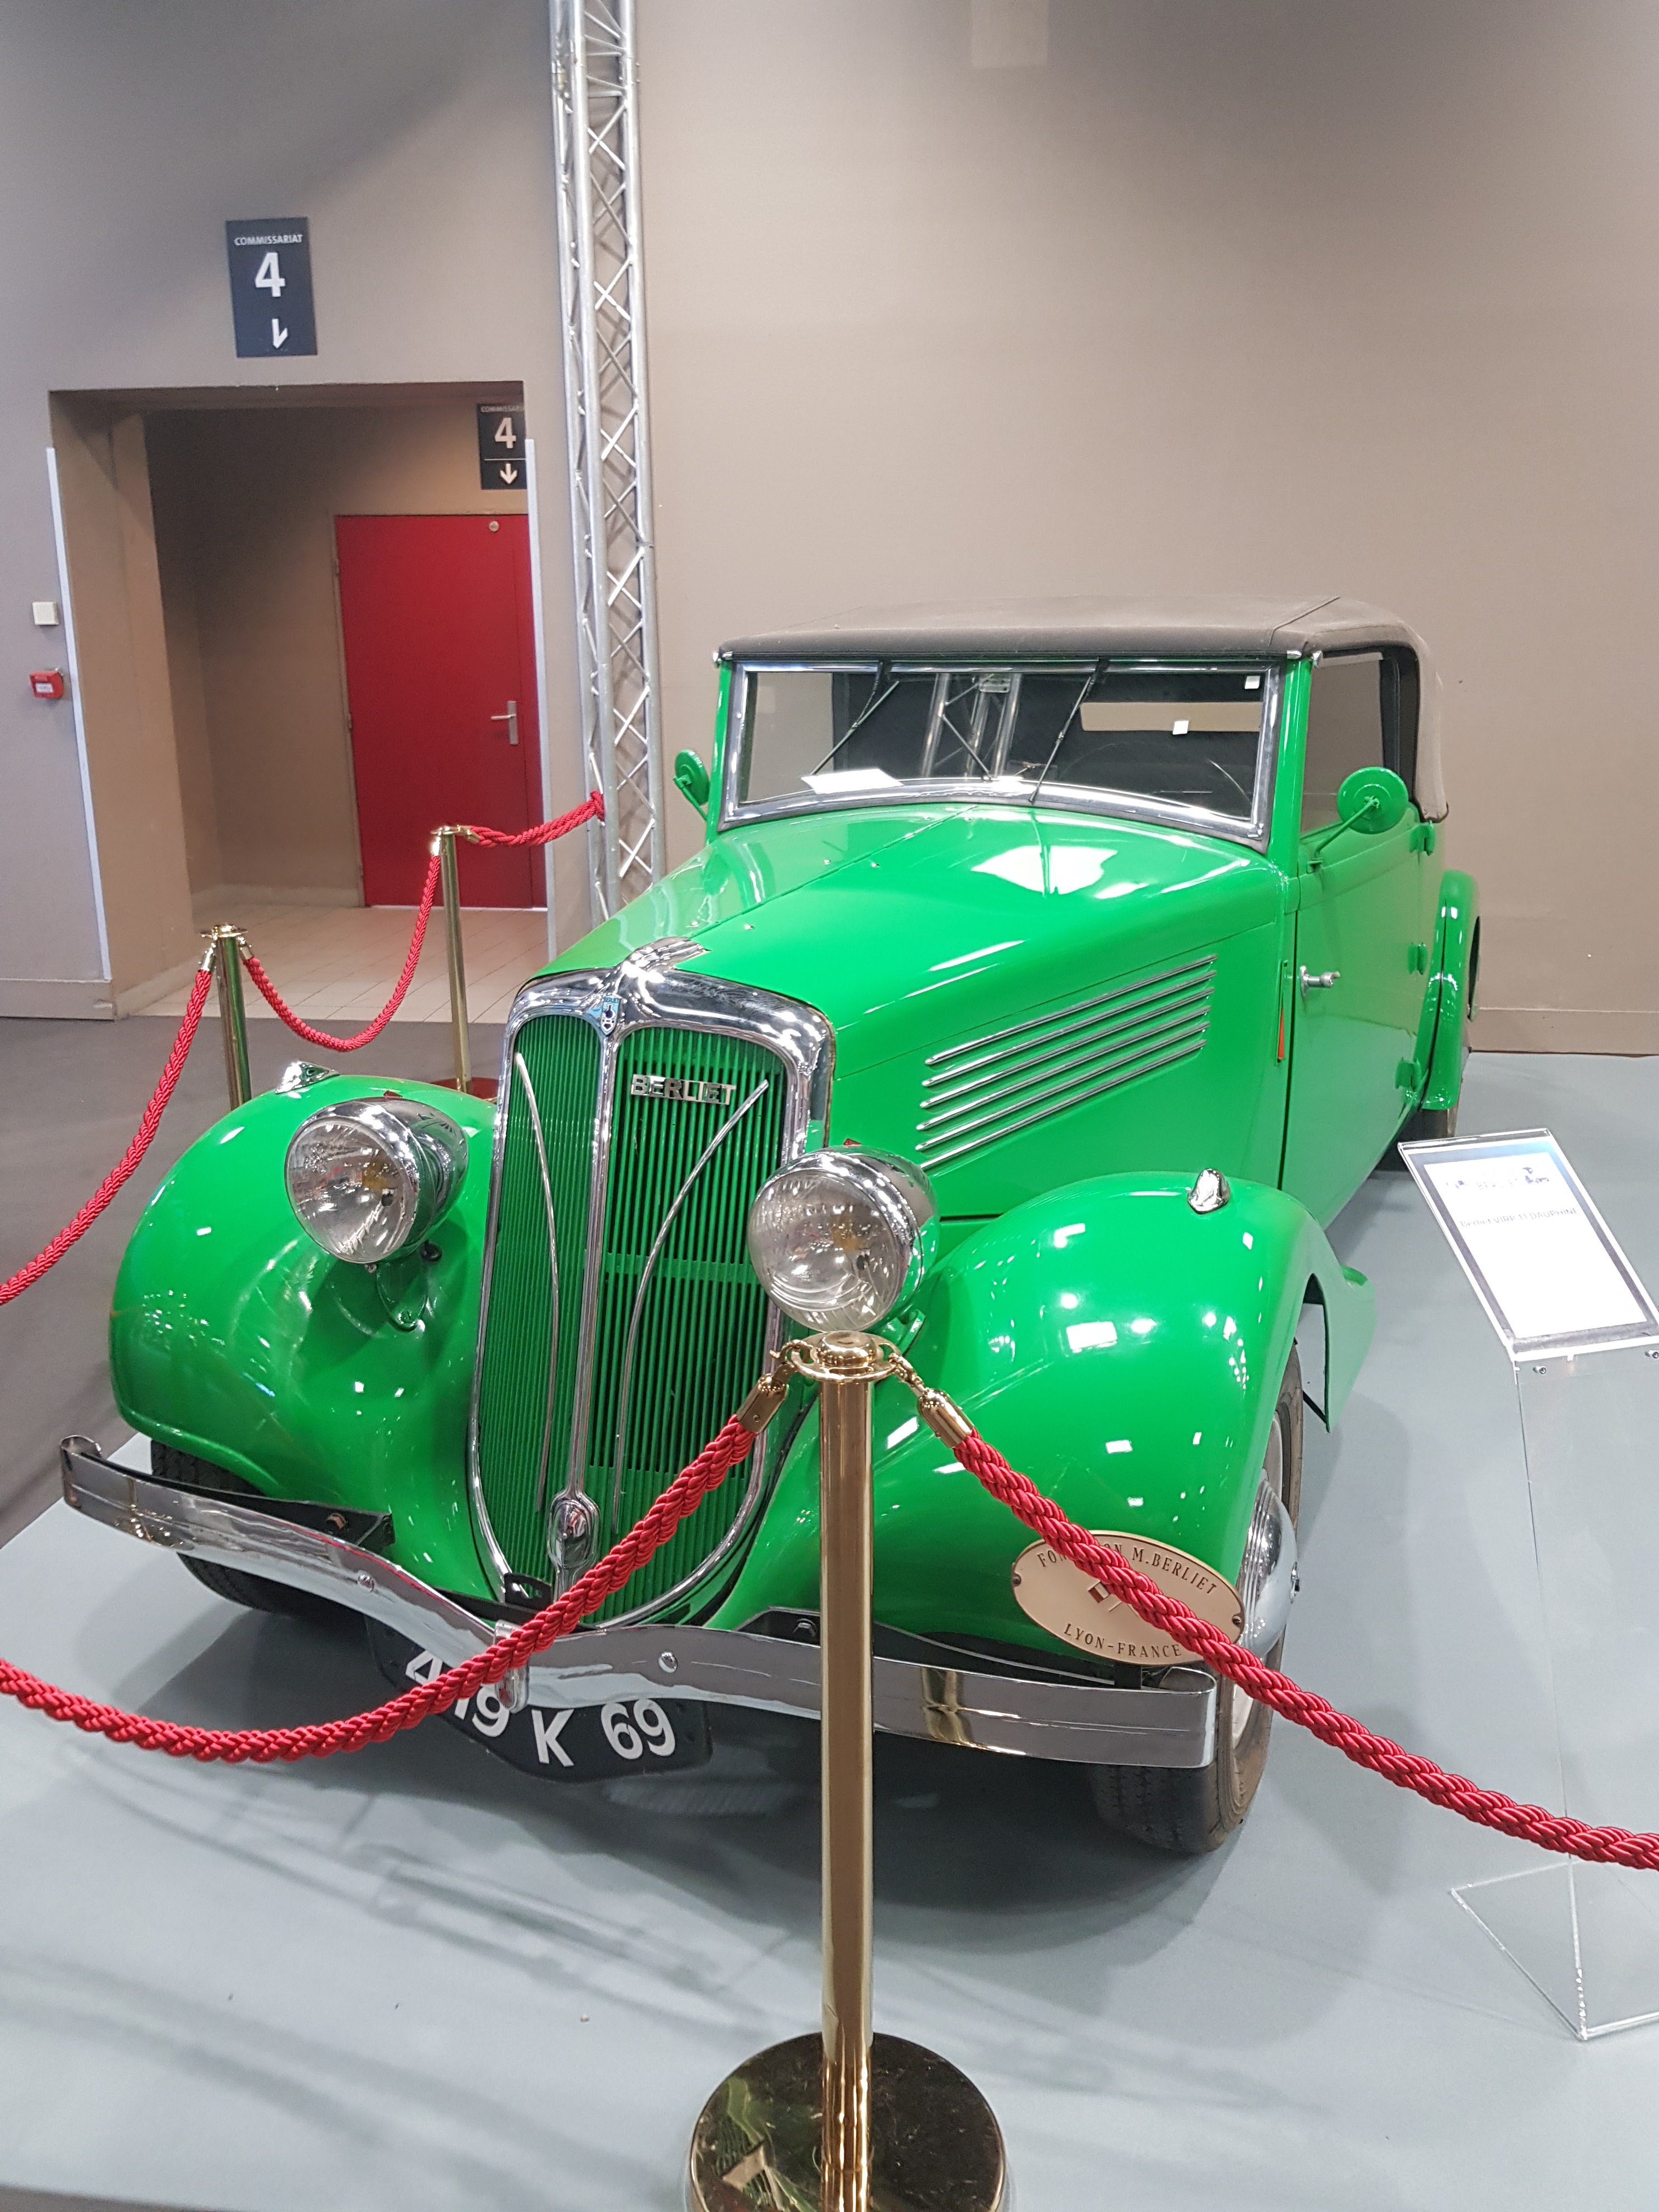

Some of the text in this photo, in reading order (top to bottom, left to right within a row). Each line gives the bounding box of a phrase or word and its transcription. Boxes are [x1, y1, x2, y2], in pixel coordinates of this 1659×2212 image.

[234, 234, 303, 246] COMMISSARIAT
[255, 252, 286, 297] 4
[494, 417, 517, 449] 4
[631, 1074, 737, 1105] BERLIET
[1132, 1546, 1217, 1595] M.BERLIET
[1063, 1623, 1182, 1658] LYON-FRANCE
[532, 1708, 575, 1767] K
[601, 1699, 676, 1760] 69
